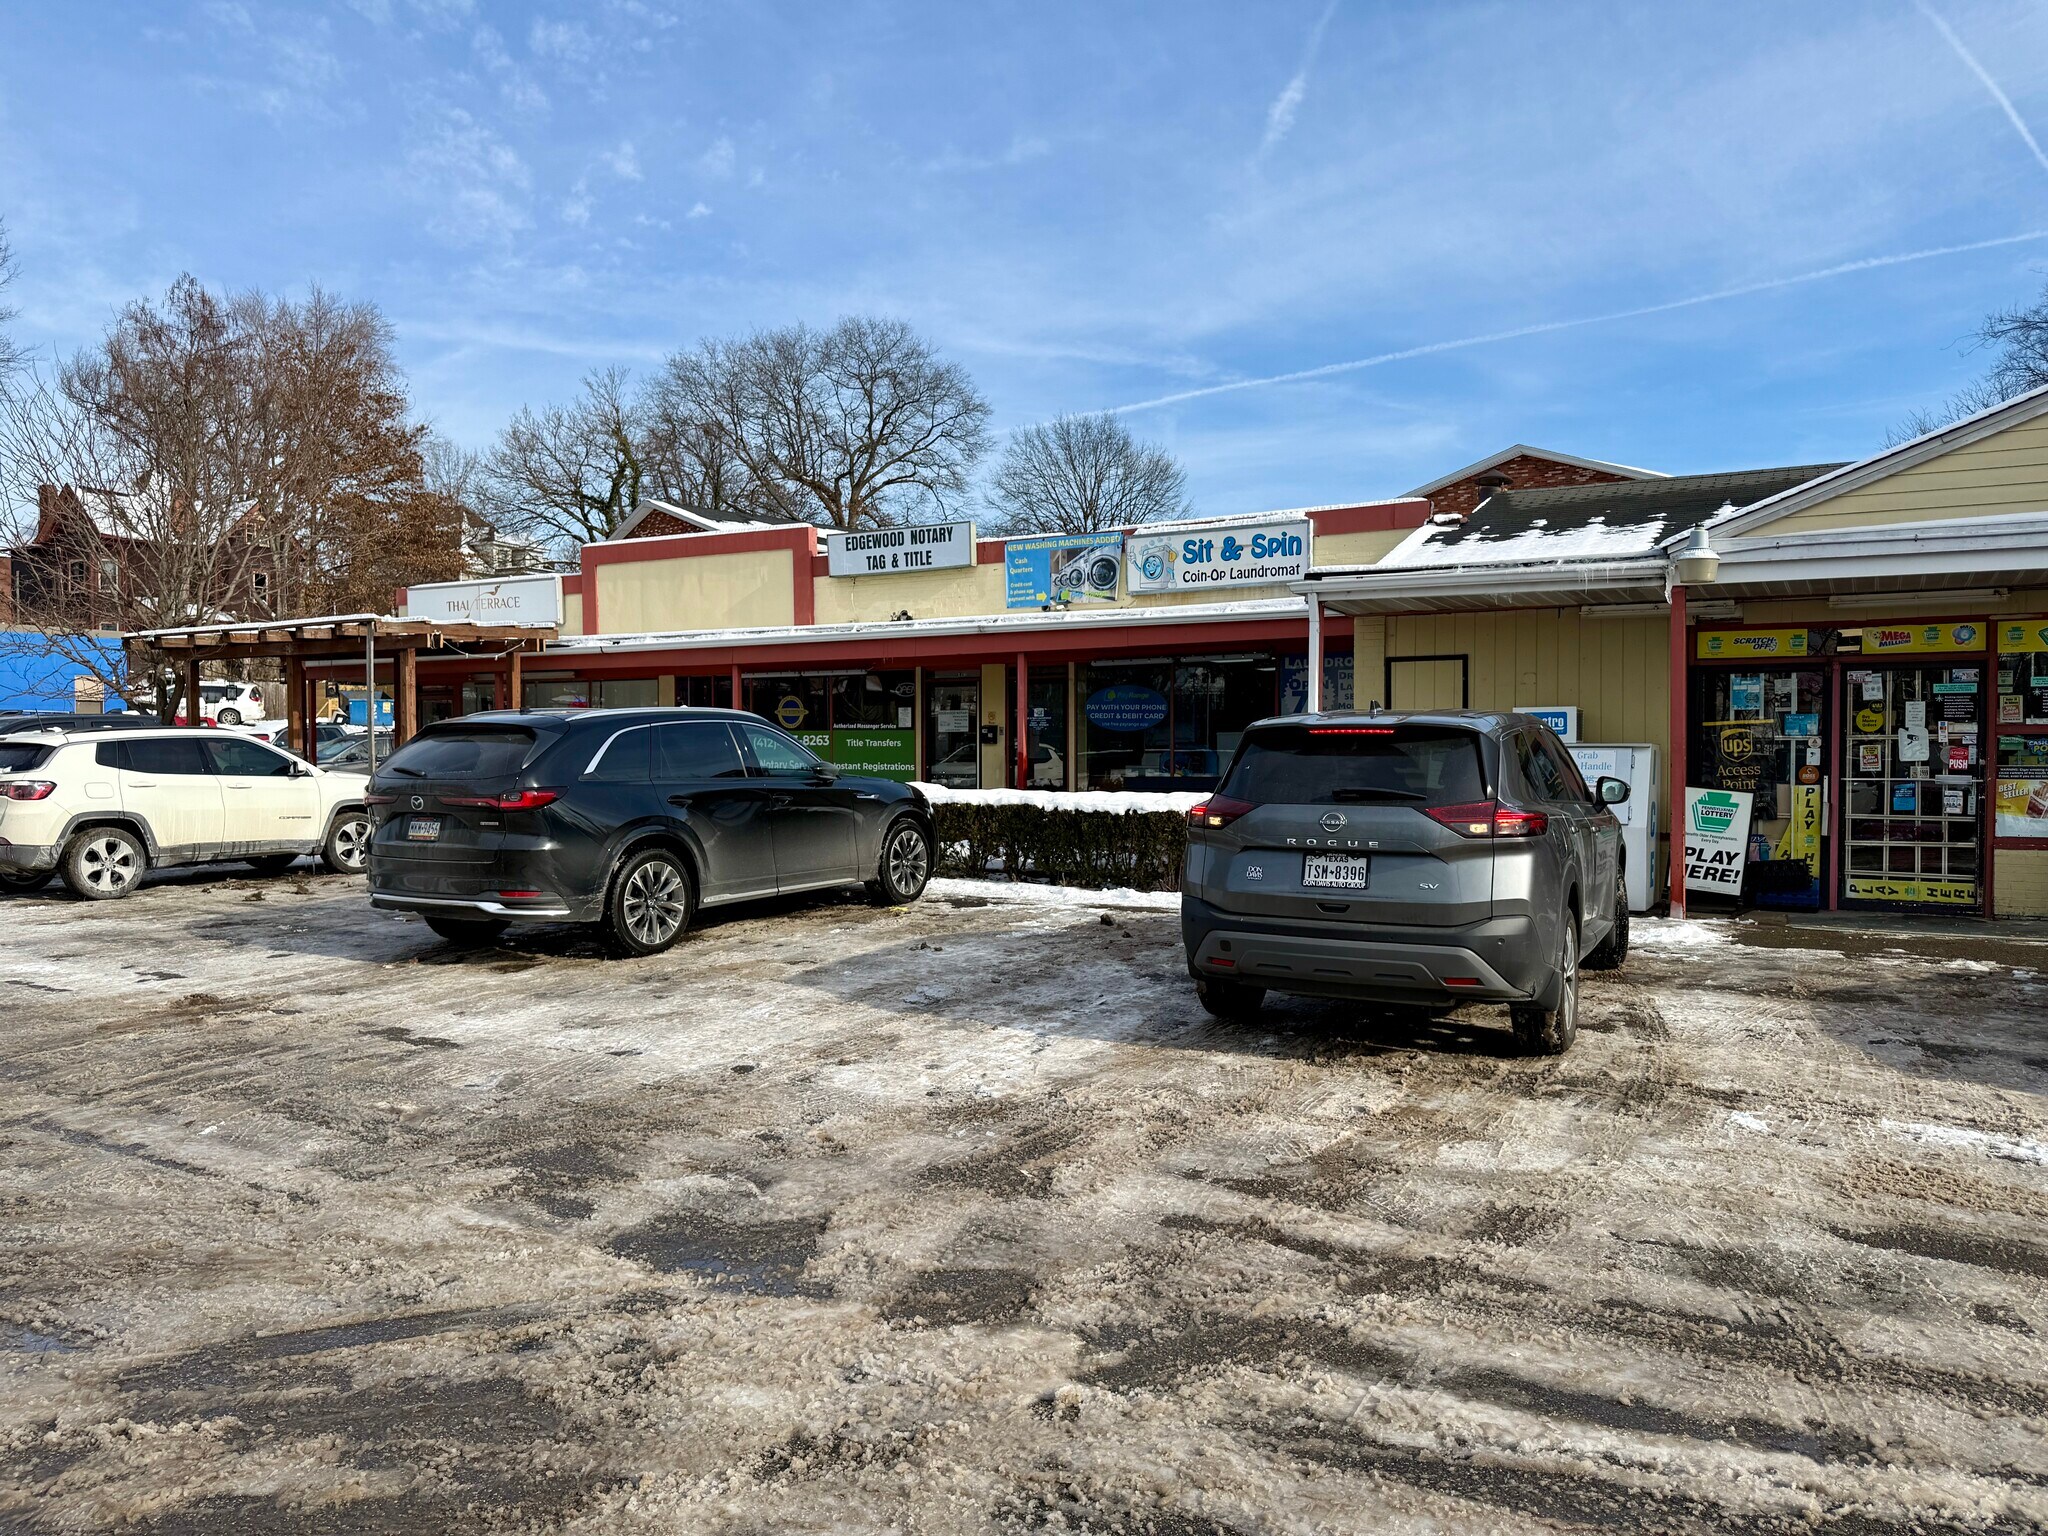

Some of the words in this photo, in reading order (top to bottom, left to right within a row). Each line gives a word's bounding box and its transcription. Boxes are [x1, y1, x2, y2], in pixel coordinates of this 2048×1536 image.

[845, 531, 905, 551] EDGEWOOD
[910, 526, 953, 545] NOTARY
[1007, 543, 1024, 552] NEW
[1025, 541, 1057, 550] WASHING
[1058, 537, 1094, 548] MACHINES
[1095, 535, 1120, 544] ADDED
[1182, 538, 1213, 564] Sit
[1220, 536, 1244, 562] &
[1250, 531, 1302, 559] Spin
[866, 554, 886, 570] TAG
[891, 553, 899, 568] &
[904, 550, 932, 567] TITLE
[1014, 557, 1028, 565] Cash
[1009, 566, 1033, 575] Quarters
[1182, 569, 1226, 583] Coin-Op
[1230, 563, 1301, 580] Laundromat
[446, 600, 469, 612] THAI
[475, 596, 521, 610] TERRACE
[1881, 630, 1911, 641] MEGA
[1878, 638, 1912, 648] MILLIONS
[846, 738, 863, 747] Title
[866, 738, 901, 747] Transfers
[1723, 739, 1751, 757] ups
[1577, 751, 1599, 760] Grab
[863, 762, 915, 771] Registrations
[1580, 761, 1612, 771] Handle
[1949, 759, 1968, 769] PUSH
[1716, 765, 1761, 777] Access
[1722, 778, 1756, 790] Point
[1998, 782, 2017, 792] BEST
[2003, 787, 2029, 799] SELLER
[1701, 805, 1734, 813] PENNSYLVANIA
[1700, 810, 1734, 819] LOTTERY
[1286, 838, 1379, 848] ROGUE
[1685, 846, 1740, 866] PLAY
[1331, 880, 1346, 888] AUTO
[1419, 882, 1440, 890] SV
